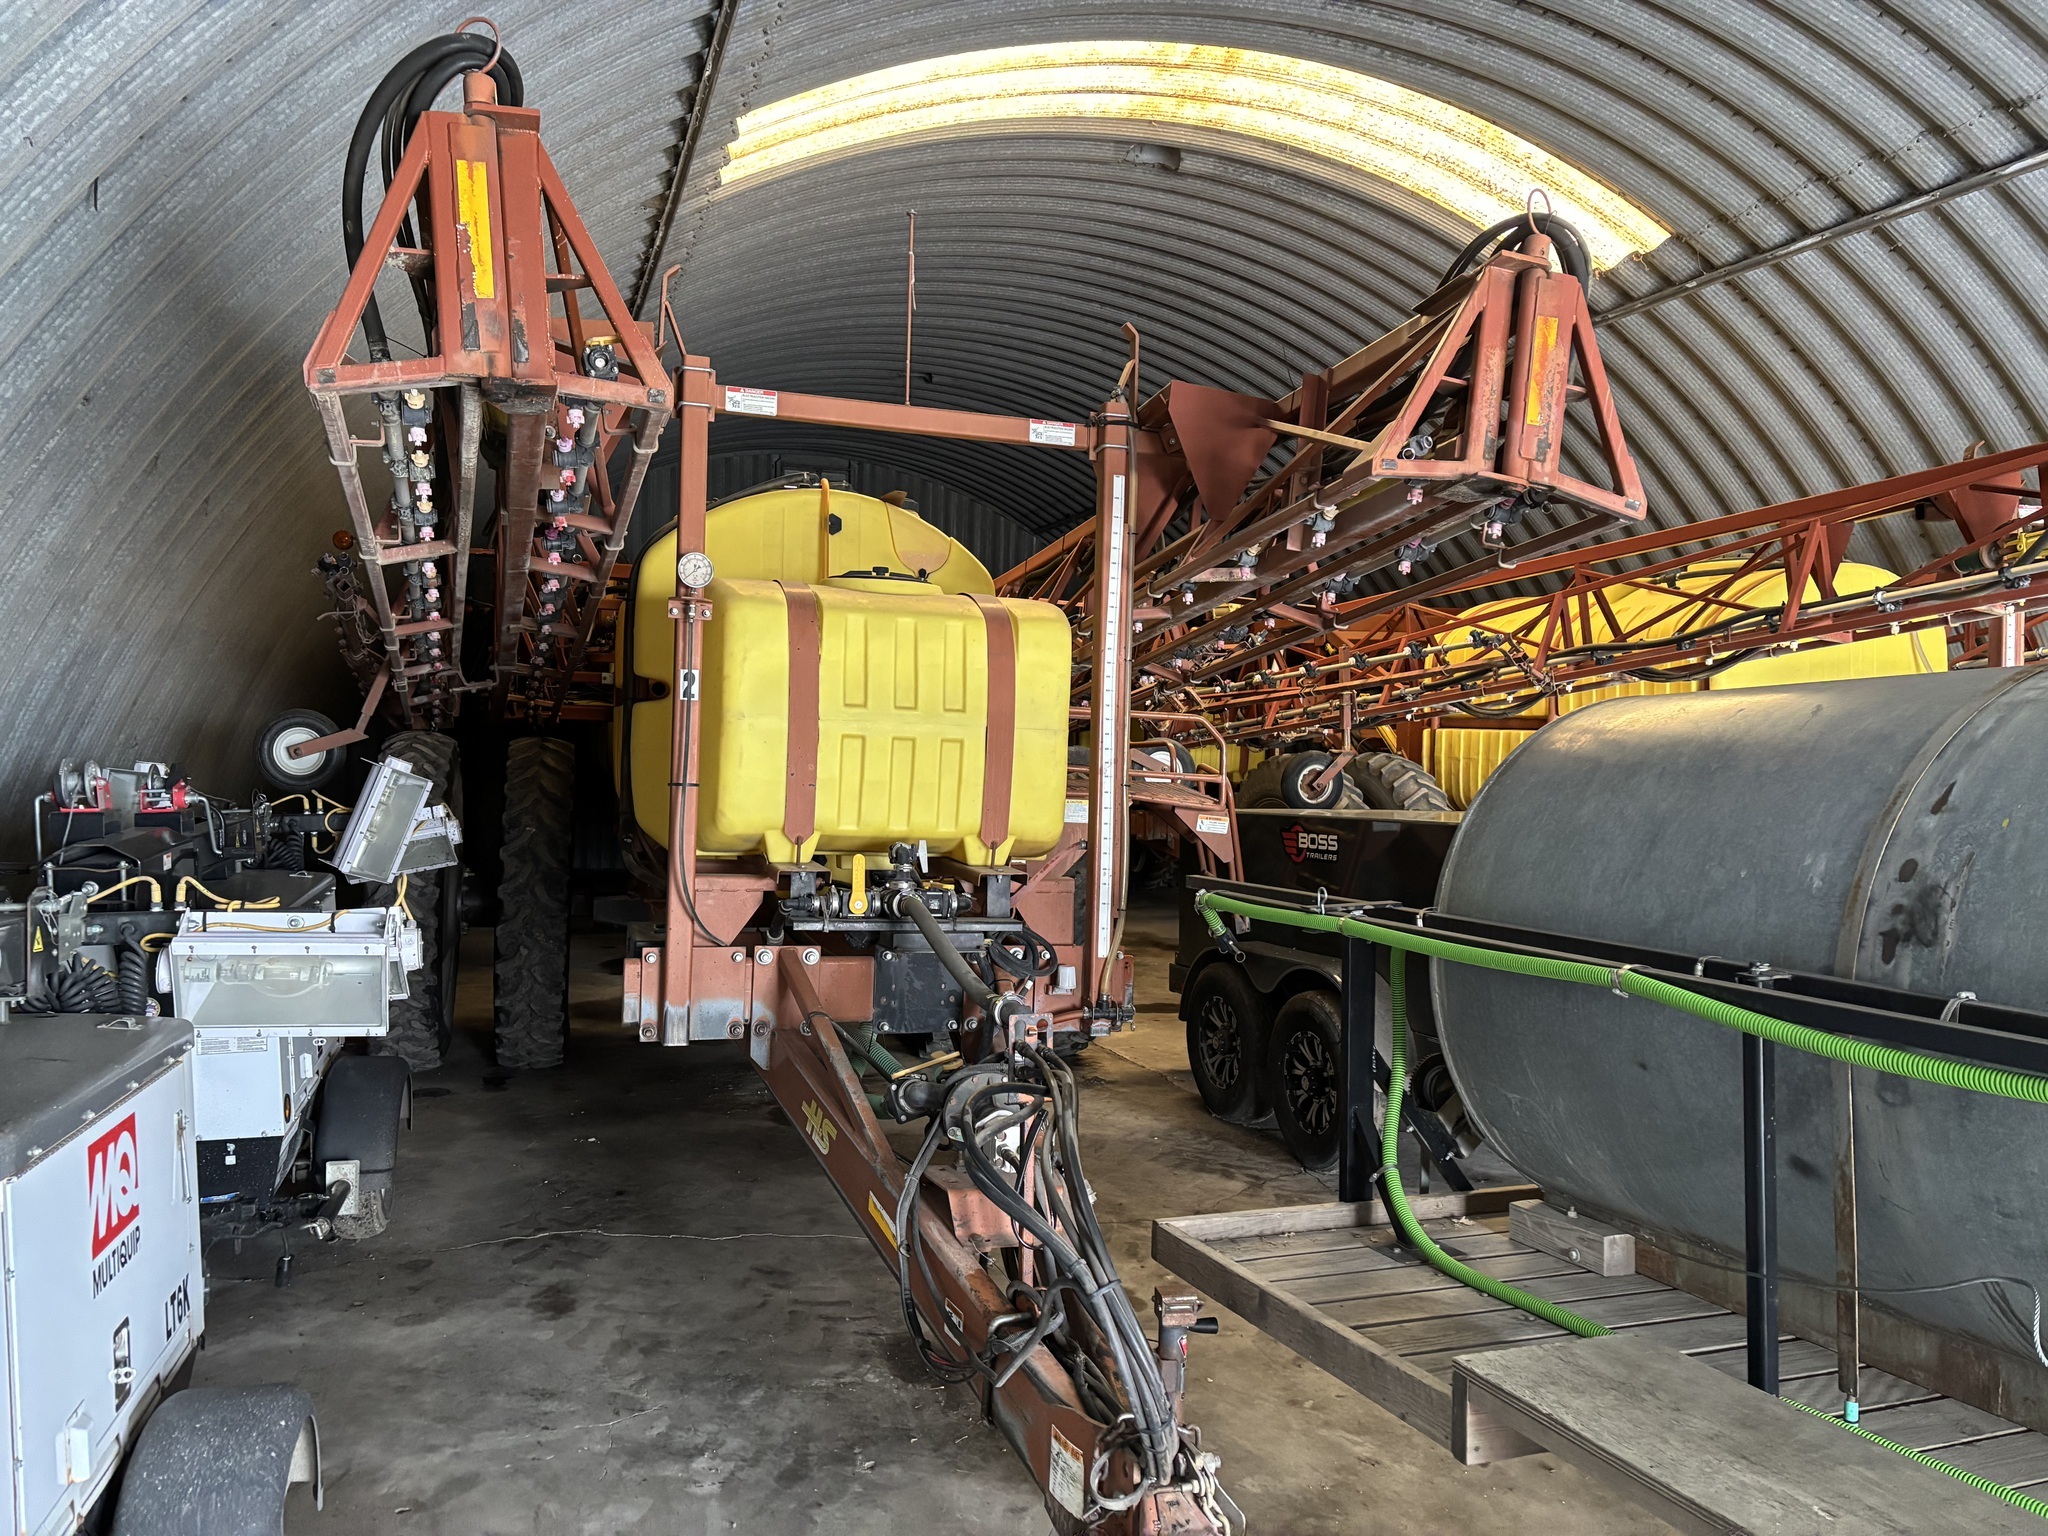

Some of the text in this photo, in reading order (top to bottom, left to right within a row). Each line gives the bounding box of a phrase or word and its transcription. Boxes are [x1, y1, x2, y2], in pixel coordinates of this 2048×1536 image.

[682, 671, 696, 698] 2
[1298, 832, 1338, 851] BOSS
[1306, 852, 1338, 861] TRAILERS
[89, 1130, 140, 1241] MQ
[92, 1225, 141, 1300] MULTIQUIP
[164, 1273, 191, 1342] LT6K
